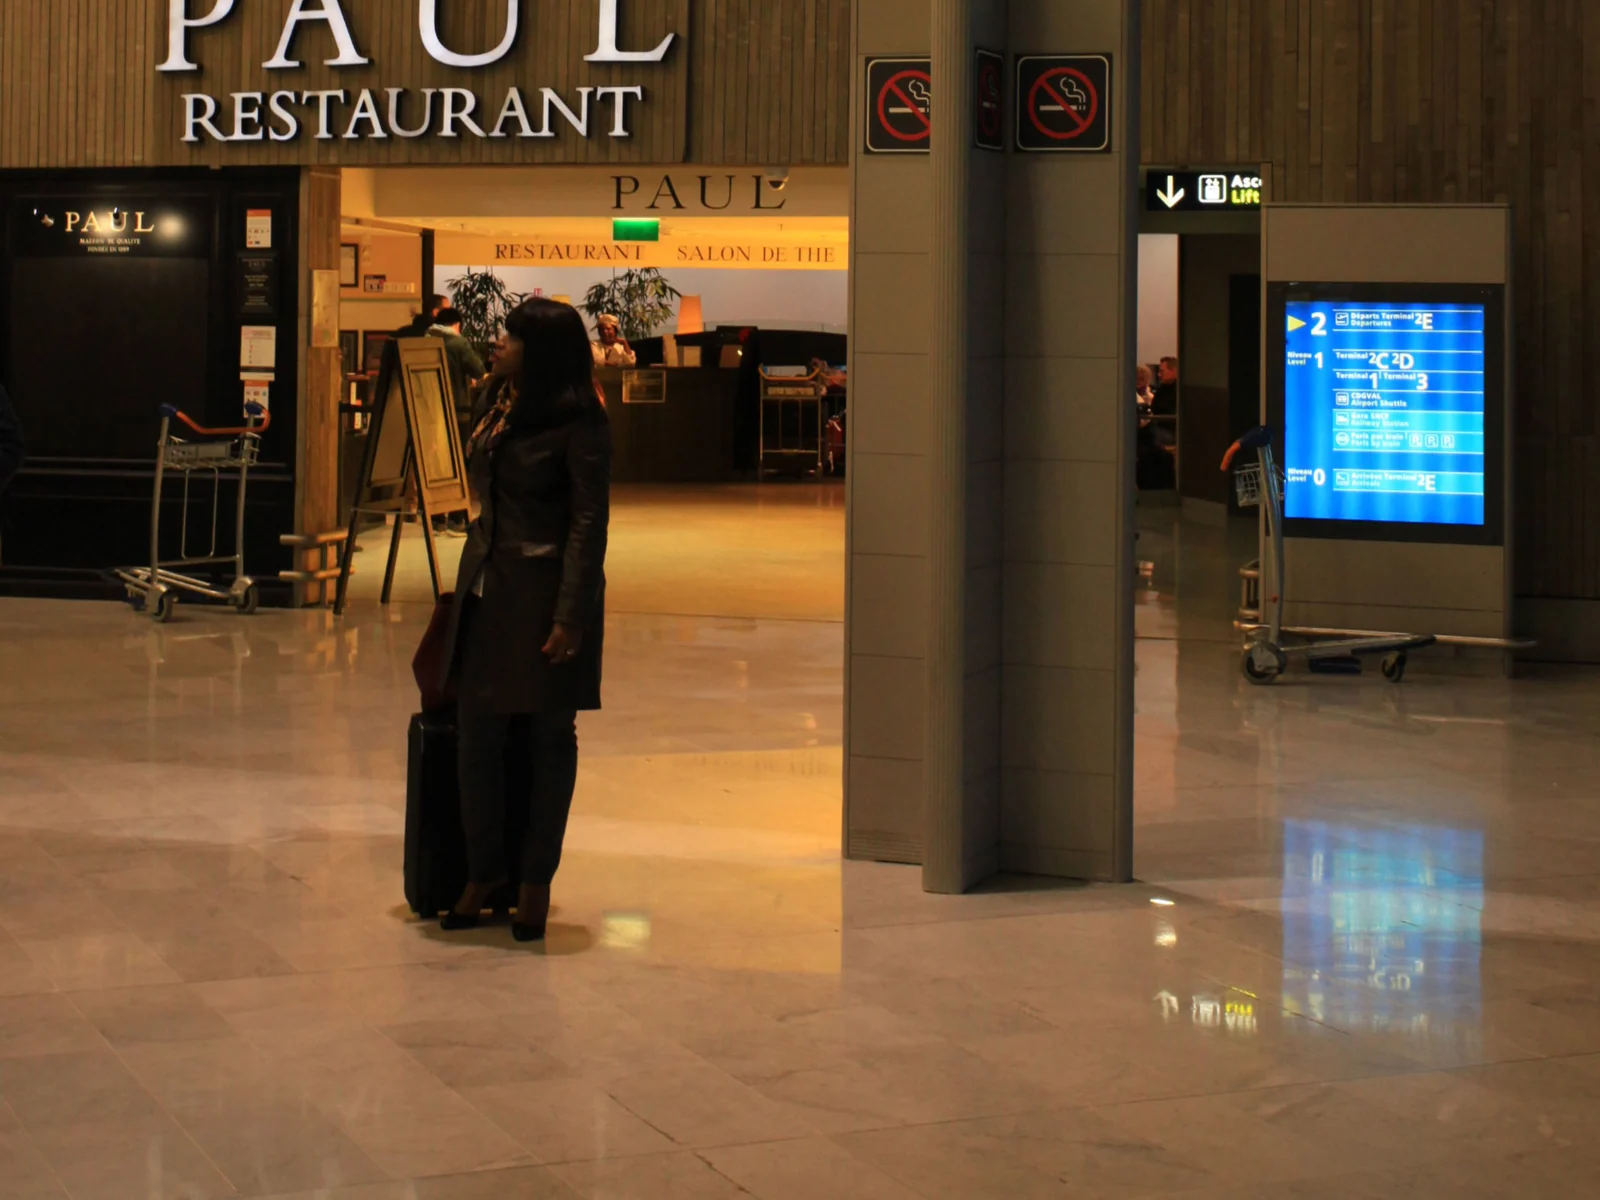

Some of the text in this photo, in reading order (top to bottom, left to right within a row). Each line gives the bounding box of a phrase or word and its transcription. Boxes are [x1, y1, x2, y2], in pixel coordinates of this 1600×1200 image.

[180, 85, 643, 143] RESTAURANT
[611, 174, 786, 210] PAUL
[1231, 189, 1260, 204] Lift
[65, 211, 155, 232] PAUL
[494, 243, 644, 261] RESTAURANT
[677, 245, 751, 262] SALON
[762, 246, 787, 263] DE
[1311, 312, 1327, 336] 2
[1351, 312, 1433, 330] Départs Terminal 2E
[1314, 352, 1323, 369] 1
[1368, 352, 1389, 369] 2C
[1392, 353, 1414, 370] 2D
[1369, 372, 1378, 390] 1
[1384, 373, 1429, 391] Terminal 3
[1351, 400, 1379, 408] Airport
[1313, 468, 1326, 486] 0
[1416, 474, 1436, 492] 2E
